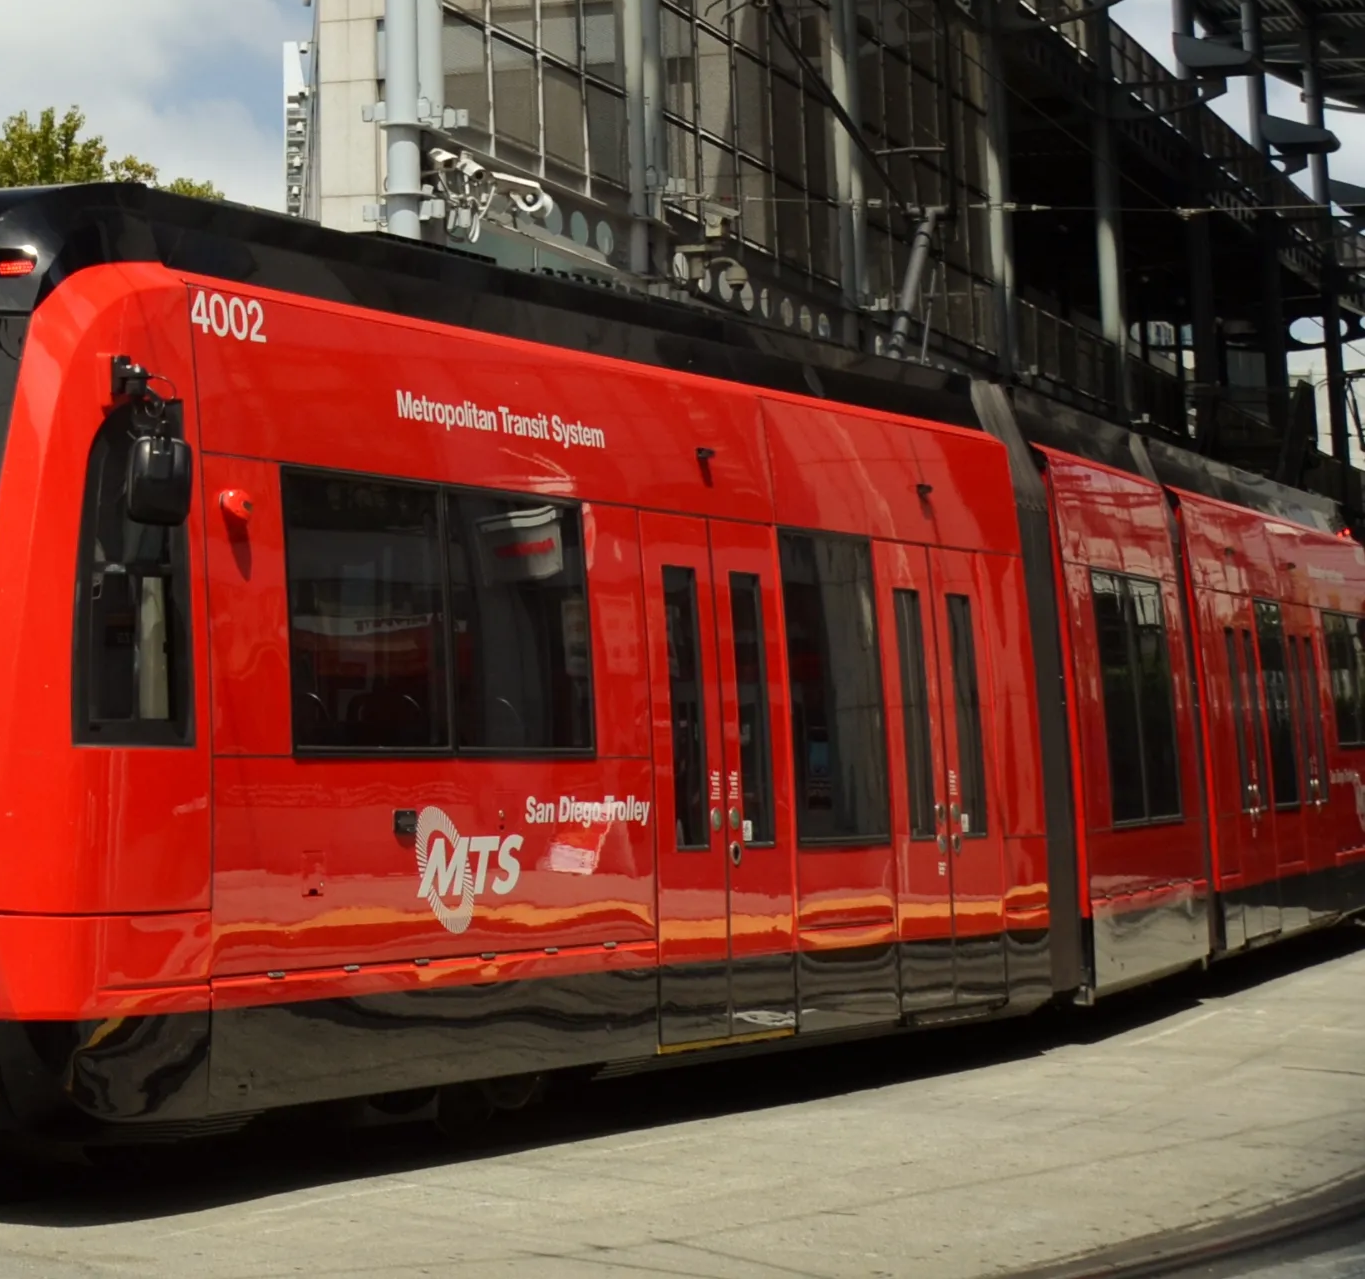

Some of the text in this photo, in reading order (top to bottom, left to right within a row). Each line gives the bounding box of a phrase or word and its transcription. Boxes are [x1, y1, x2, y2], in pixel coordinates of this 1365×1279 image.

[191, 290, 267, 343] 4002
[396, 389, 606, 449] Metropolitan Transit System
[524, 795, 651, 827] San Diego Trolley
[417, 834, 524, 898] MTS
